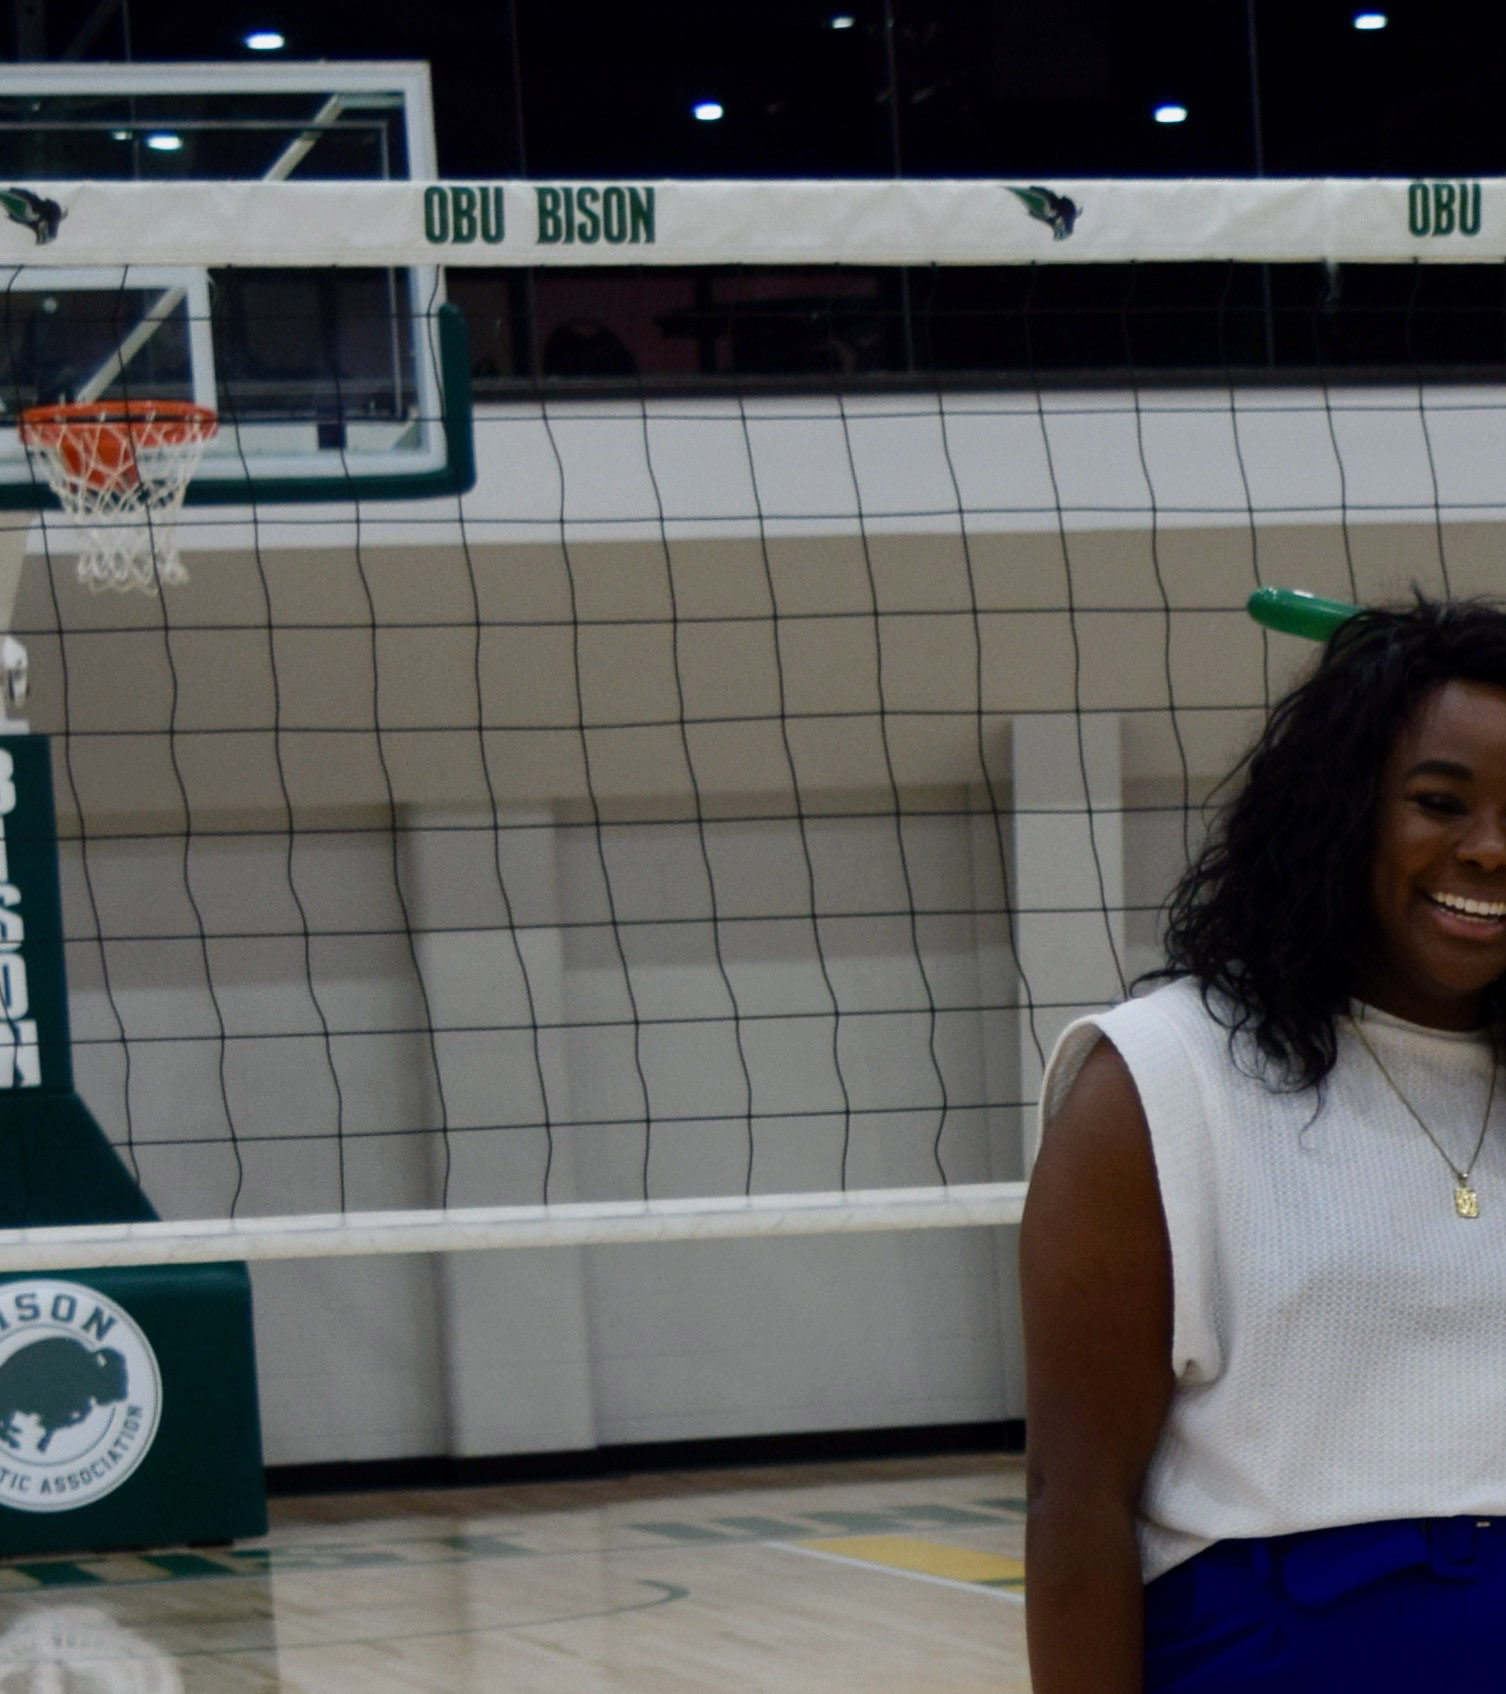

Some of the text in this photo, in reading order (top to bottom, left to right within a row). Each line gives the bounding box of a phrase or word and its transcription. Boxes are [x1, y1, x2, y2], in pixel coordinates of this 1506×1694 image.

[424, 186, 656, 244] OBU BISON
[1408, 182, 1482, 237] OBU
[40, 1406, 143, 1495] ASSOCIATION
